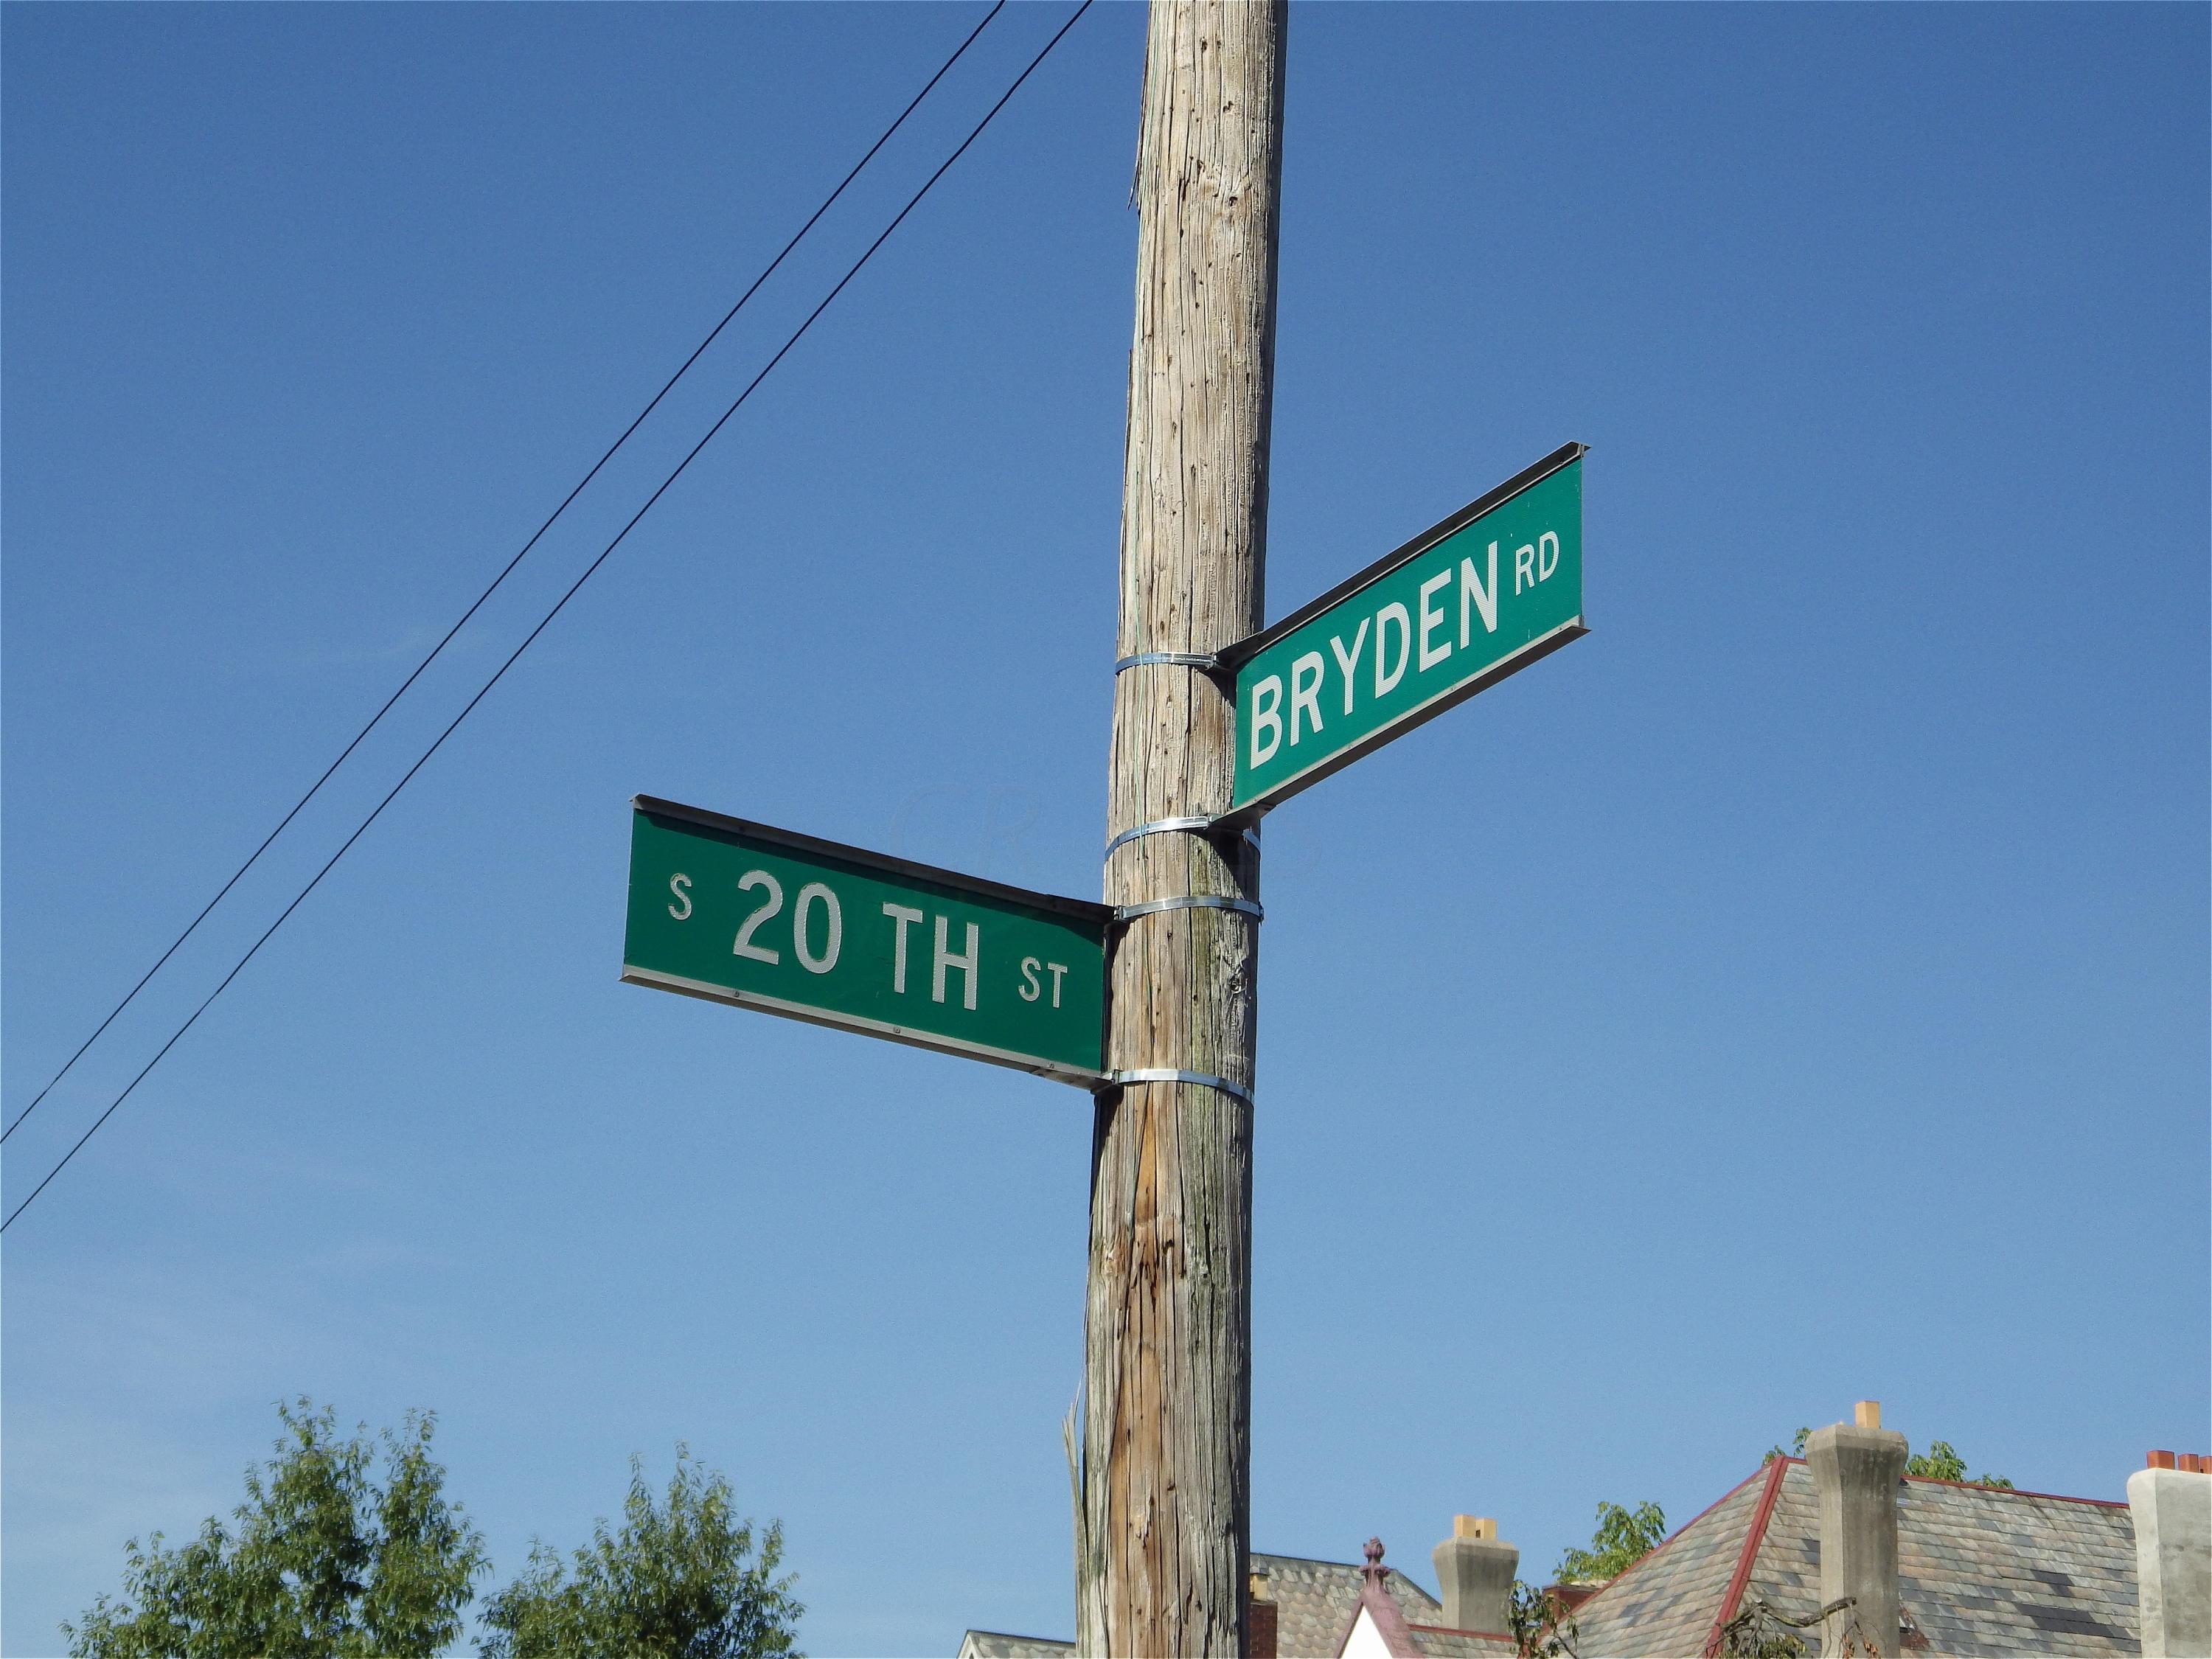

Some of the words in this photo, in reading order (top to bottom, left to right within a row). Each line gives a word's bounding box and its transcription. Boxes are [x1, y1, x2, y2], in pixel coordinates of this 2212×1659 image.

[1250, 540, 1498, 771] BRYDEN
[1515, 530, 1559, 596] RD
[668, 872, 692, 920] S
[733, 869, 842, 974] 20
[882, 902, 979, 1011] TH
[1018, 956, 1068, 1008] ST
